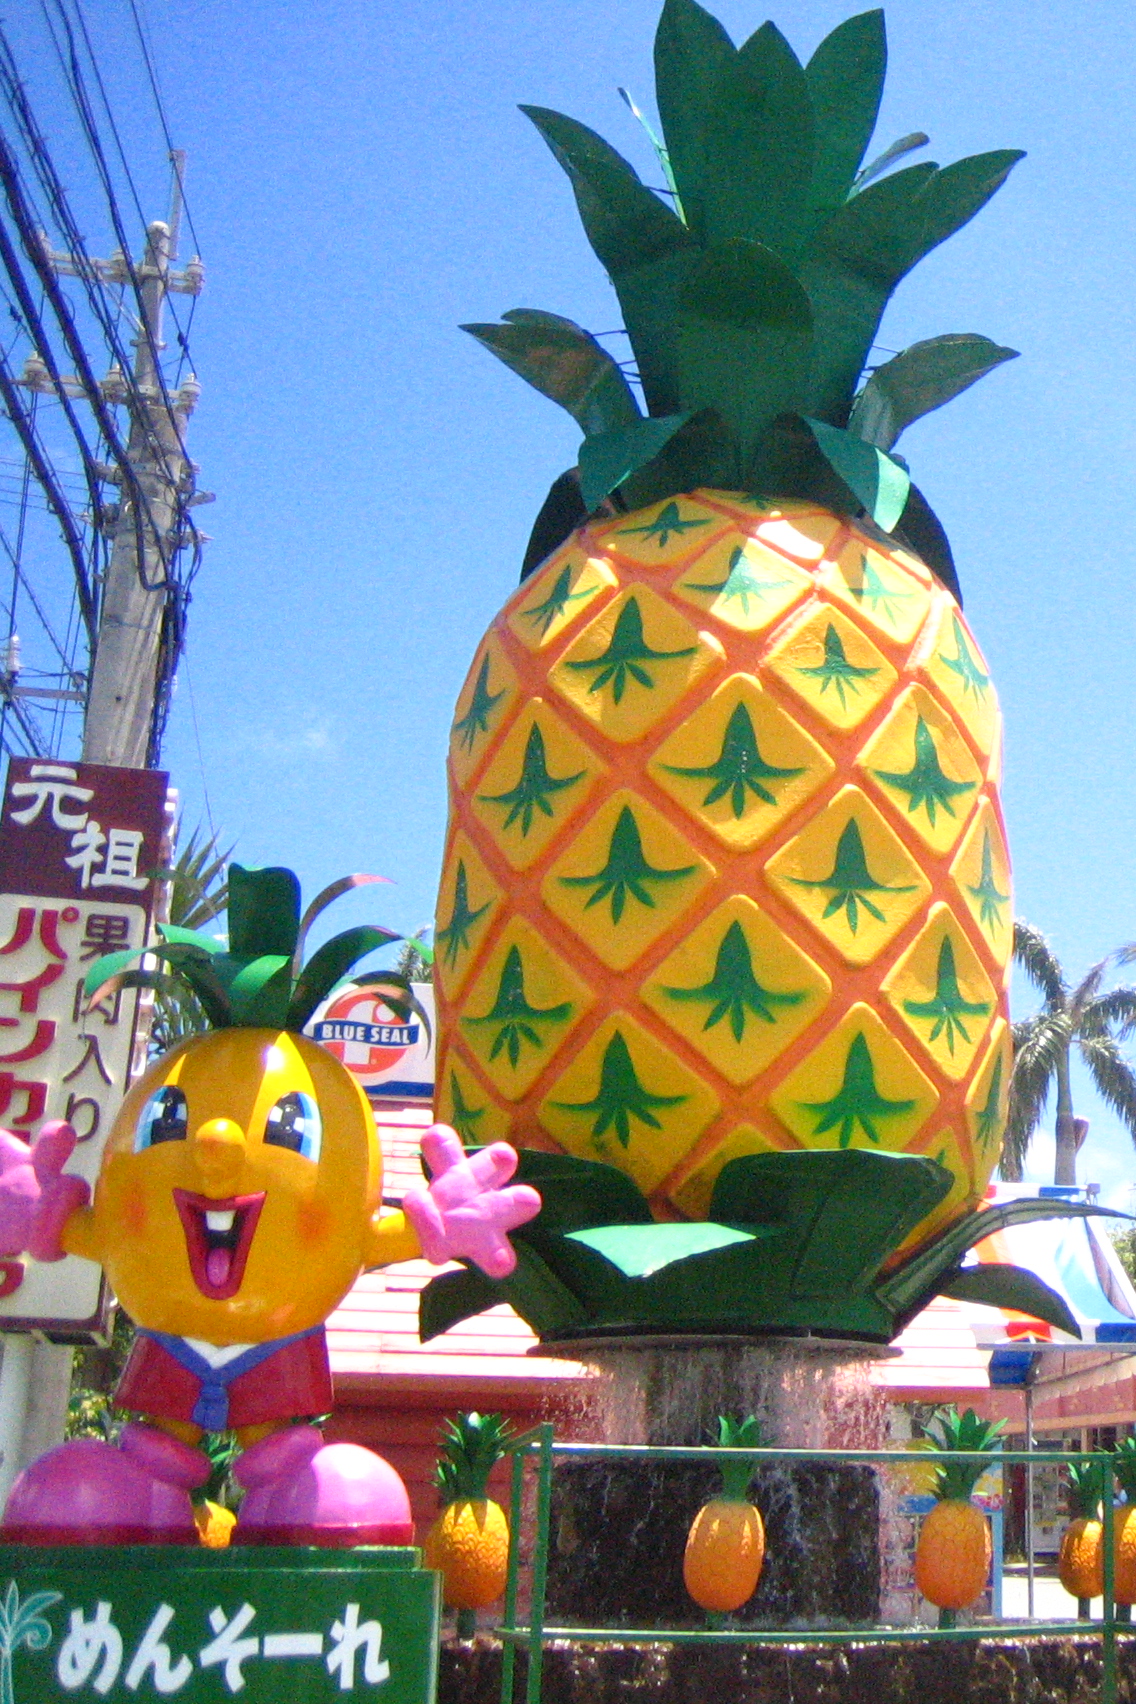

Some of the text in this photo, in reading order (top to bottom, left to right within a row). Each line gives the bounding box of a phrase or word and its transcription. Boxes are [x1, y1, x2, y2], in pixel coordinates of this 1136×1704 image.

[10, 765, 149, 891] 元祖
[63, 913, 131, 1143] 果肉入り
[322, 1024, 410, 1044] BLUE SEAL
[57, 1601, 391, 1694] めんそーれ
